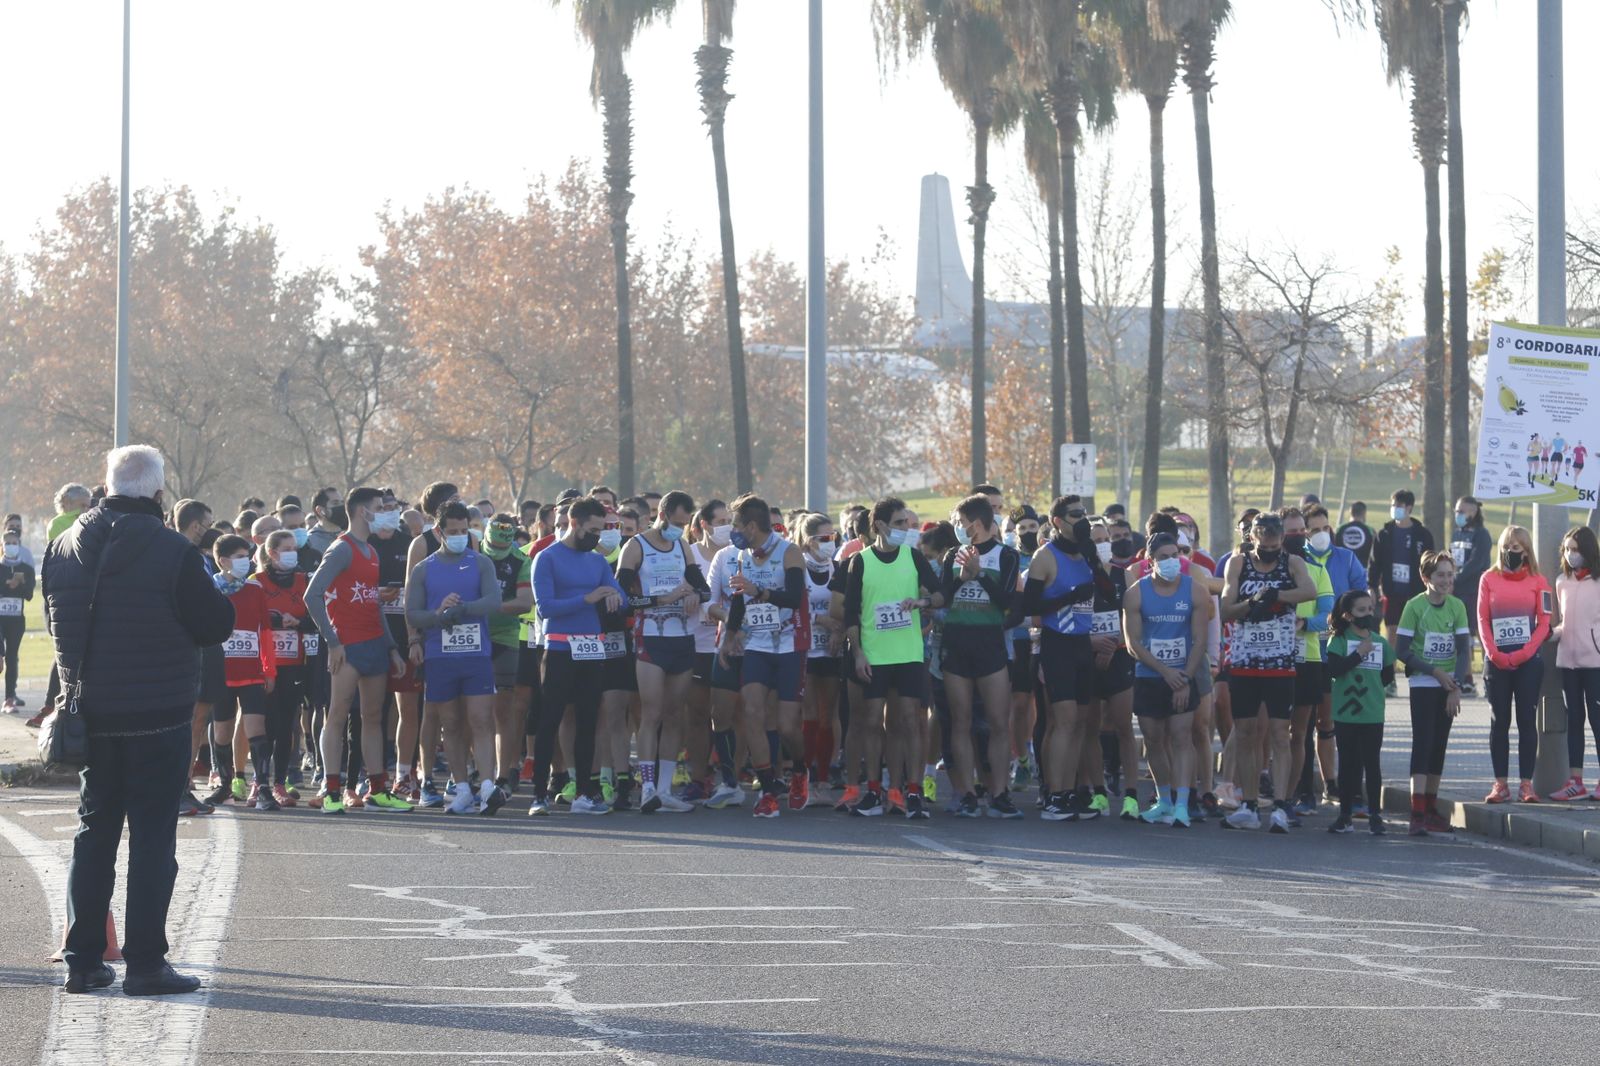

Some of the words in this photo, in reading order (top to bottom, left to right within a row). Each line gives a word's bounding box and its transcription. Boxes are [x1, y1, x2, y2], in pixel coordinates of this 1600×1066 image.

[1514, 338, 1600, 357] CORDOBARI
[1578, 489, 1596, 501] 5K
[960, 587, 983, 598] 557
[751, 613, 773, 625] 314
[880, 611, 903, 623] 311
[1091, 621, 1114, 633] 541
[1499, 627, 1523, 638] 309
[448, 634, 475, 645] 456
[1250, 631, 1275, 642] 389
[228, 640, 252, 650] 399
[303, 639, 318, 649] 00
[576, 642, 599, 652] 498
[604, 642, 619, 651] 20
[1429, 640, 1449, 650] 382
[1156, 648, 1180, 659] 479
